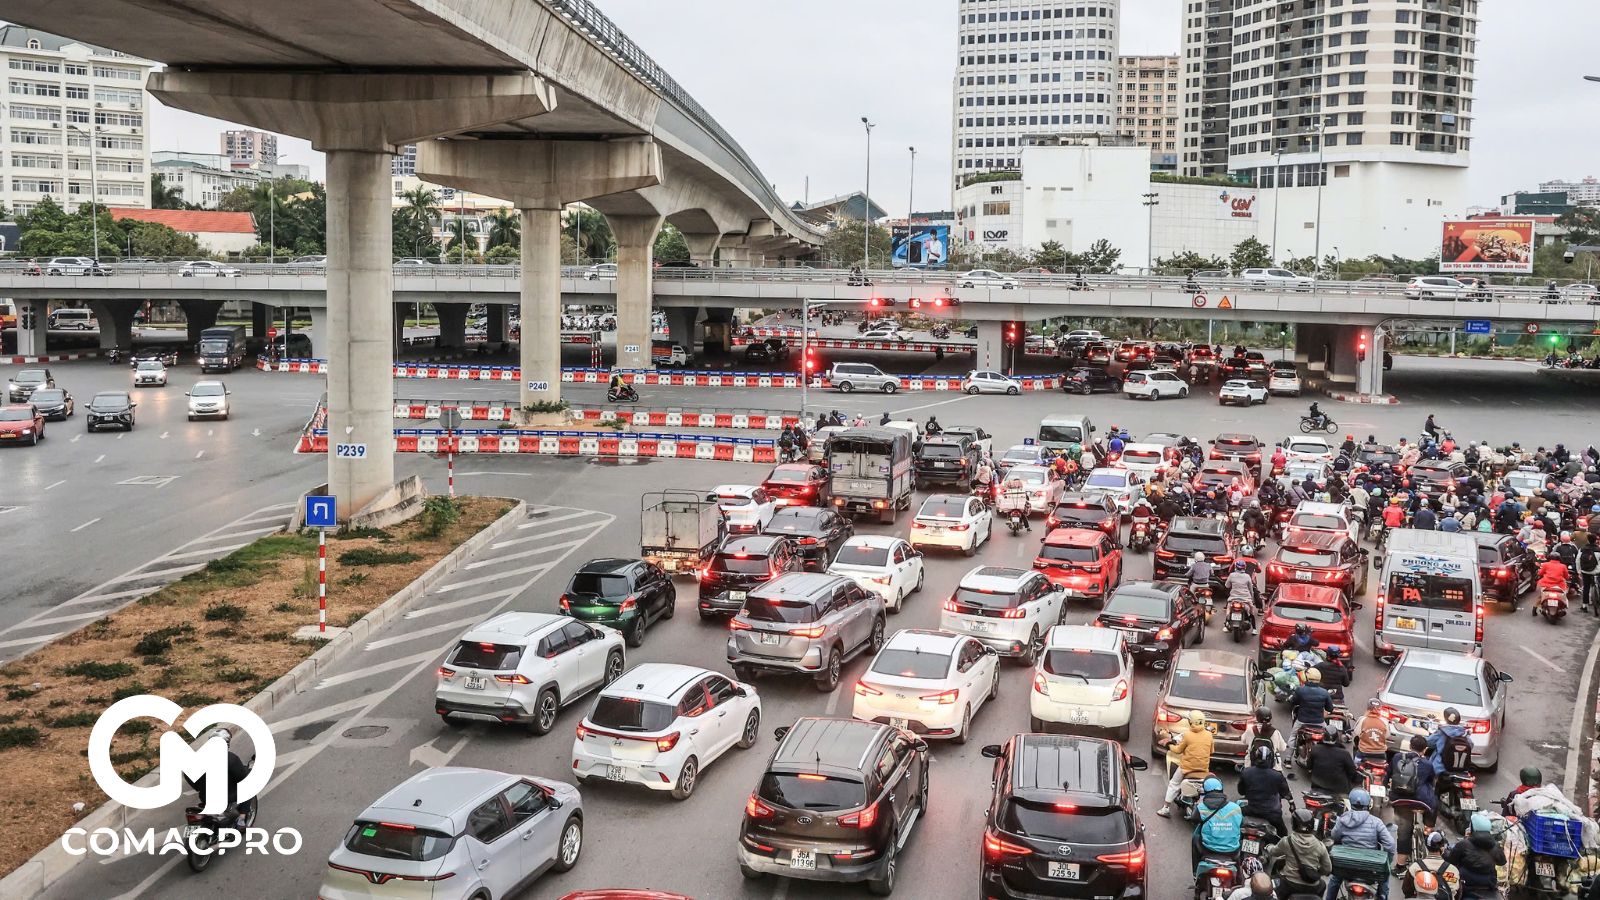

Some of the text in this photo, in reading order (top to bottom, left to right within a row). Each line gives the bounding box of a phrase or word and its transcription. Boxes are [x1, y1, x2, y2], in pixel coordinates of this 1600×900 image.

[1231, 198, 1252, 210] CGV
[984, 231, 1008, 239] LOOP
[529, 382, 547, 390] P240
[337, 445, 365, 456] P239
[1057, 862, 1071, 871] 30L
